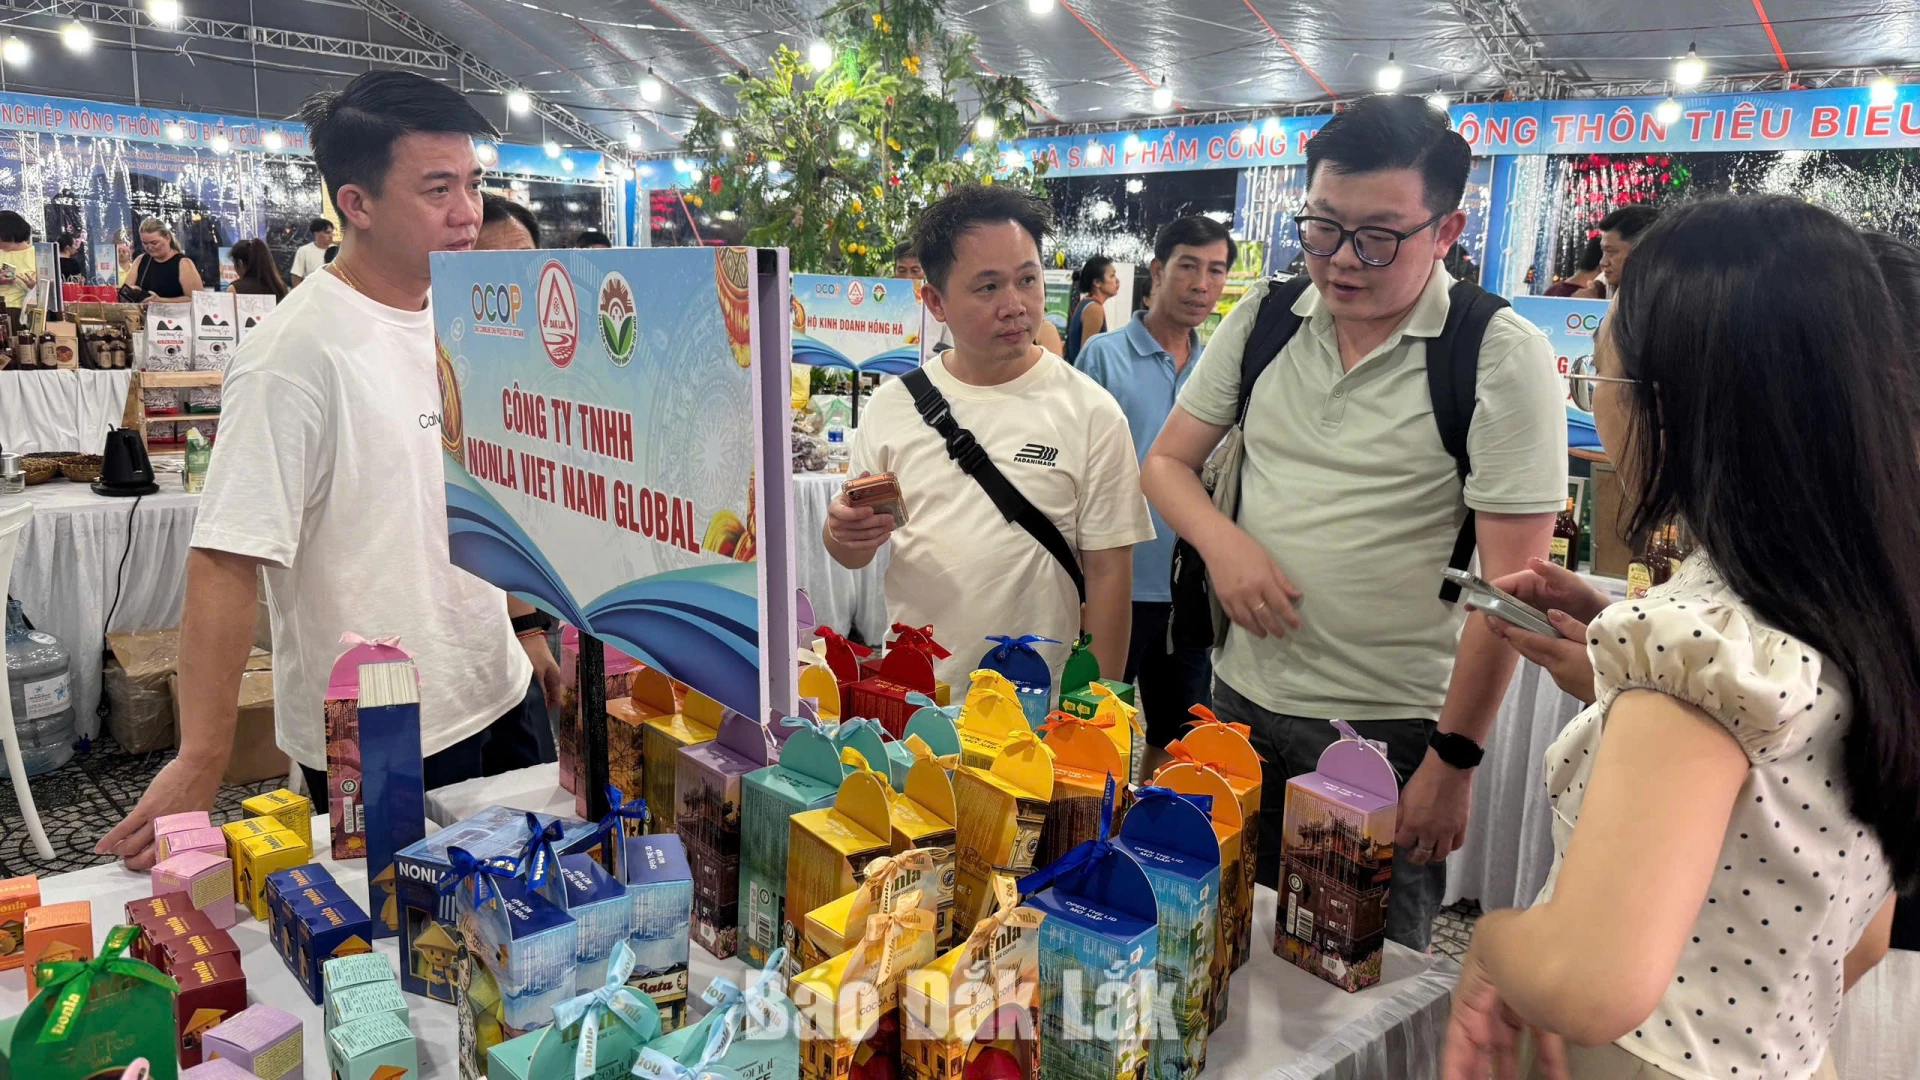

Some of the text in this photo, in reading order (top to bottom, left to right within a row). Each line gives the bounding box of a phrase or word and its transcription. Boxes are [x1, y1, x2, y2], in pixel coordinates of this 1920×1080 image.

[1, 103, 63, 131] NGHIỆP
[69, 107, 114, 133] NÔNG
[117, 113, 160, 136] THÔN
[1459, 112, 1537, 147] ÔNG
[1552, 106, 1668, 144] THÔN
[1686, 102, 1793, 141] TIÊU
[472, 283, 522, 325] OCOP
[819, 317, 837, 330] KINH
[840, 318, 866, 332] DOANH
[419, 411, 441, 429] Calv
[502, 381, 634, 463] CÔNG TY TNHH
[467, 436, 701, 555] NONLA VIET NAM GLOBAL
[148, 898, 167, 917] nonla
[302, 888, 324, 906] nonla
[321, 907, 344, 926] nonla
[1065, 901, 1088, 911] OPEN
[1088, 908, 1103, 917] THE
[165, 916, 187, 936] nonla
[186, 935, 209, 955] nonla
[884, 938, 896, 975] nonla
[191, 960, 214, 983] nonla
[51, 993, 81, 1035] nonla
[859, 994, 890, 1016] COCOA
[968, 996, 997, 1016] COCOA
